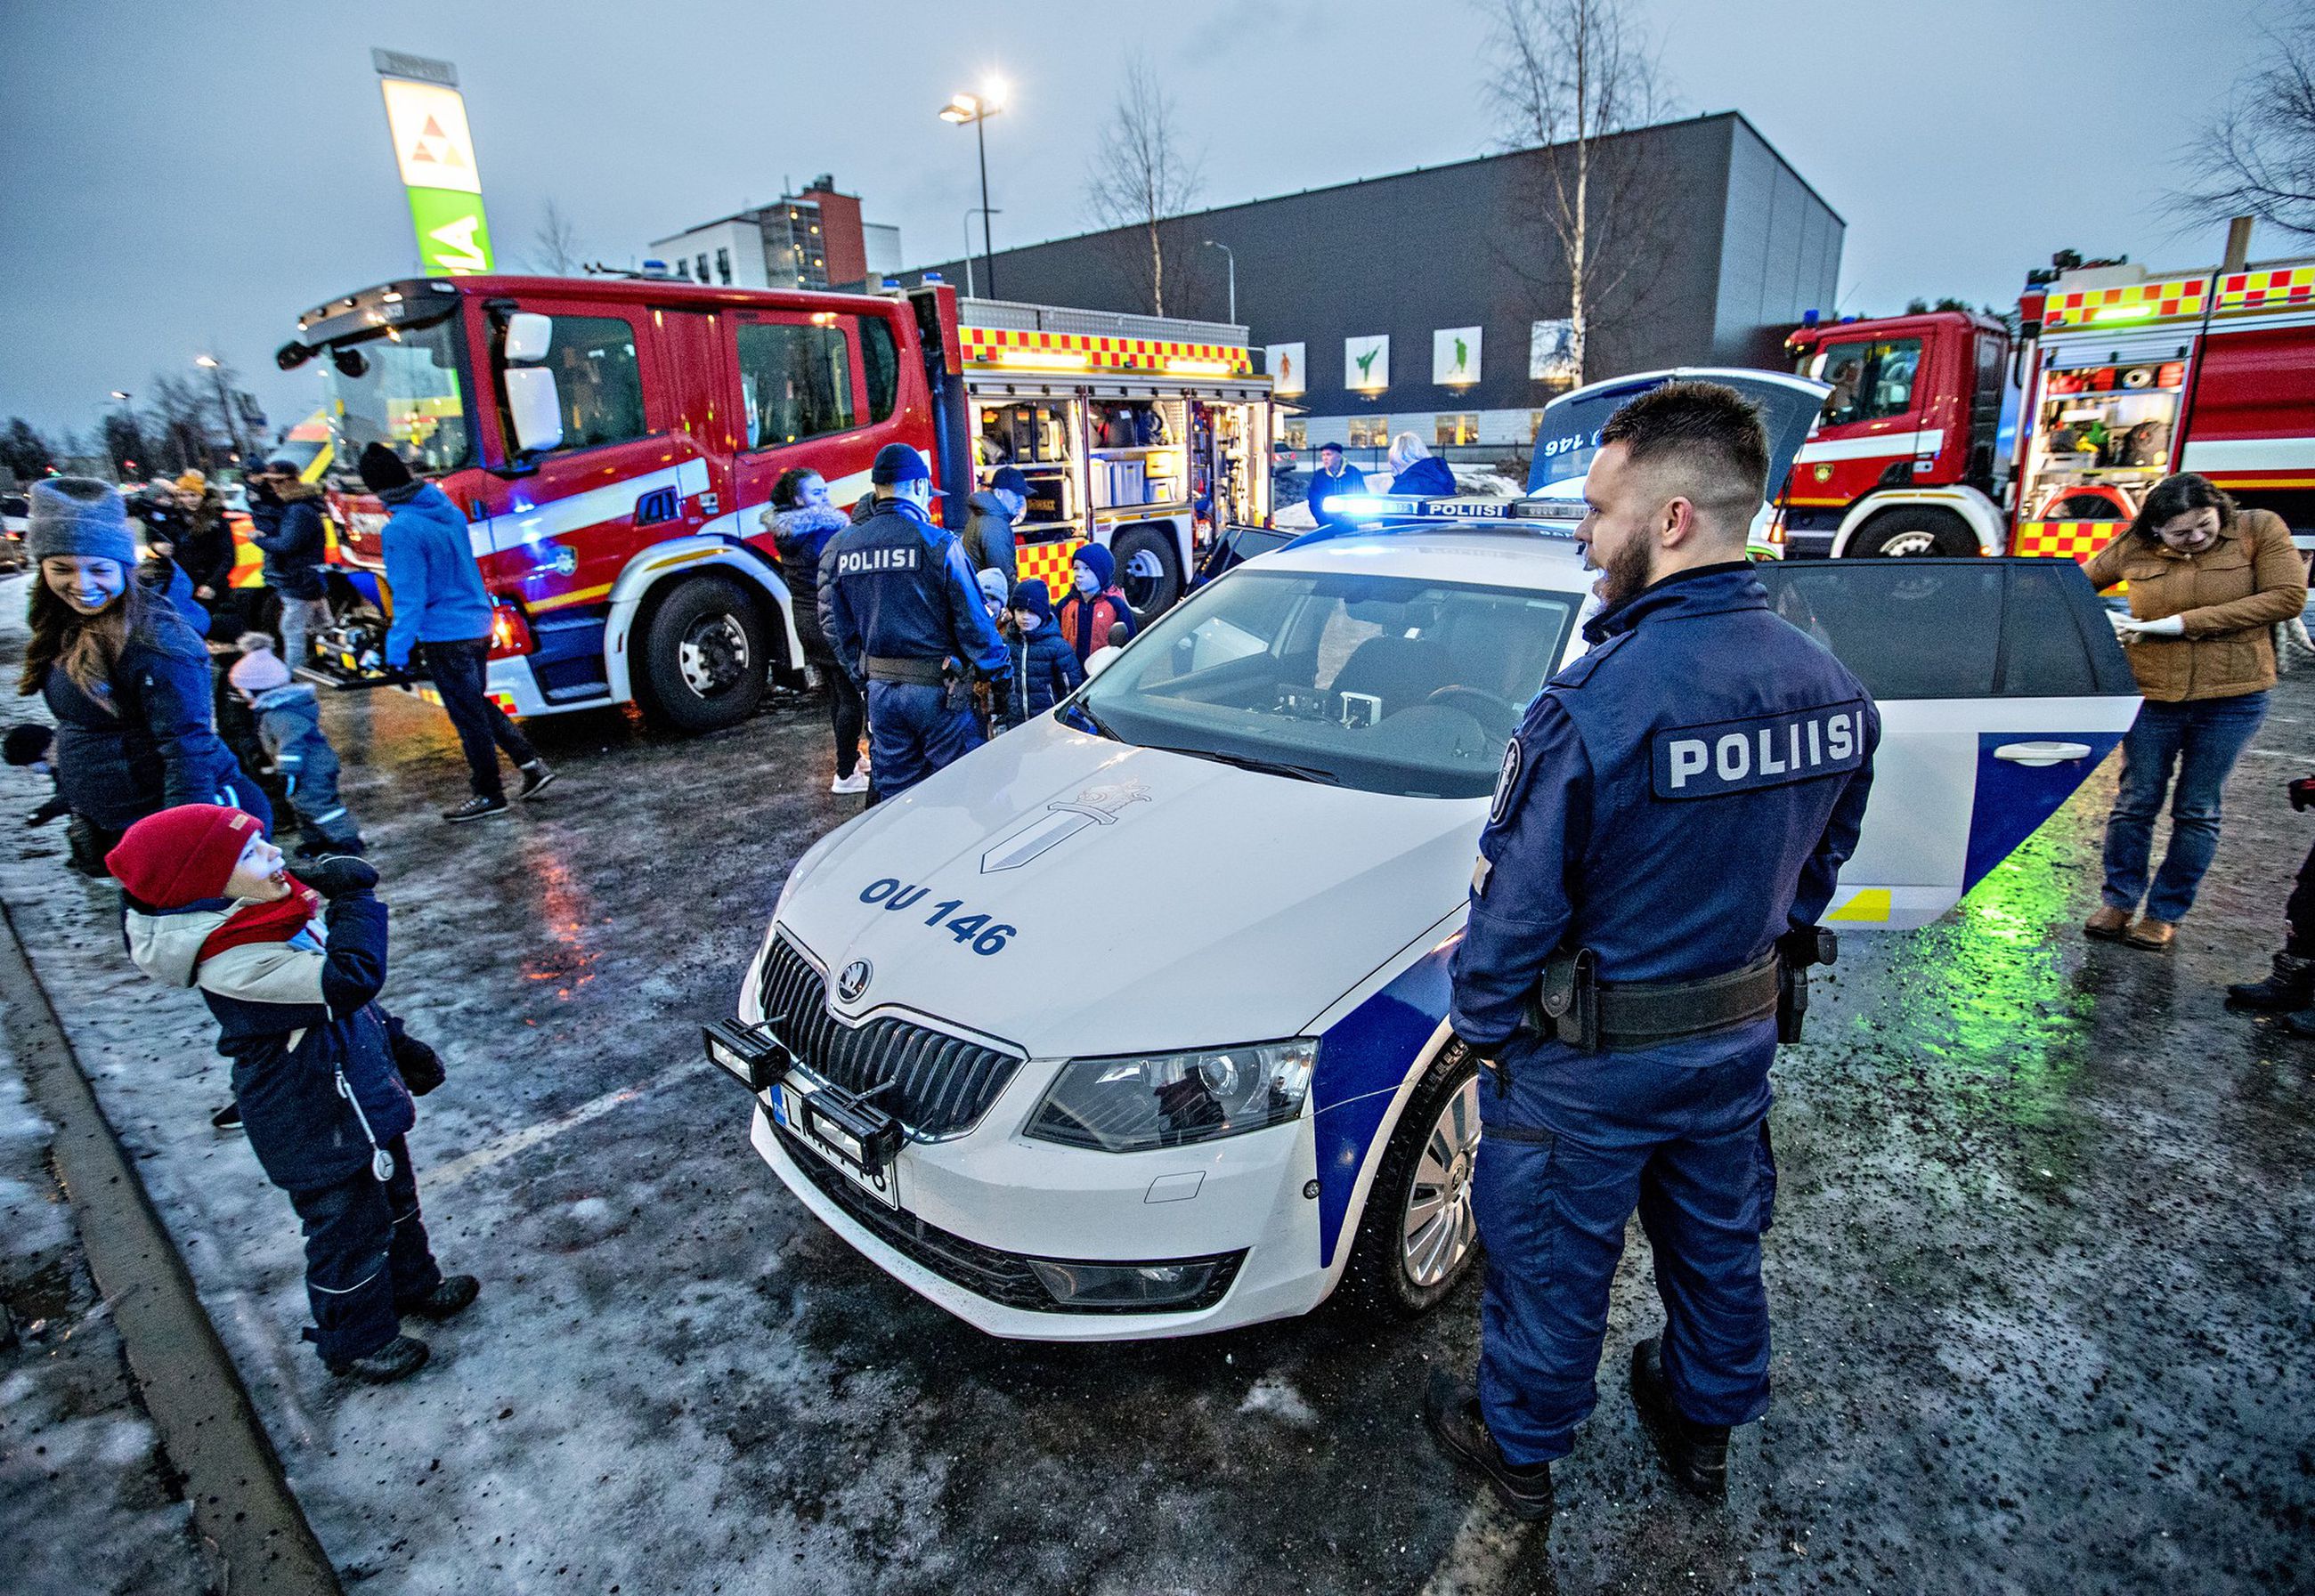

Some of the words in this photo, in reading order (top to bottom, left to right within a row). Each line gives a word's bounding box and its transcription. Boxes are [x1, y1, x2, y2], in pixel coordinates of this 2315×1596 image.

[1544, 433, 1584, 457] 146
[1429, 504, 1504, 517] POLIISI
[839, 548, 915, 574] POLIISI
[1669, 711, 1863, 789] POLIISI
[859, 878, 931, 911] OU
[924, 899, 1017, 956] 146
